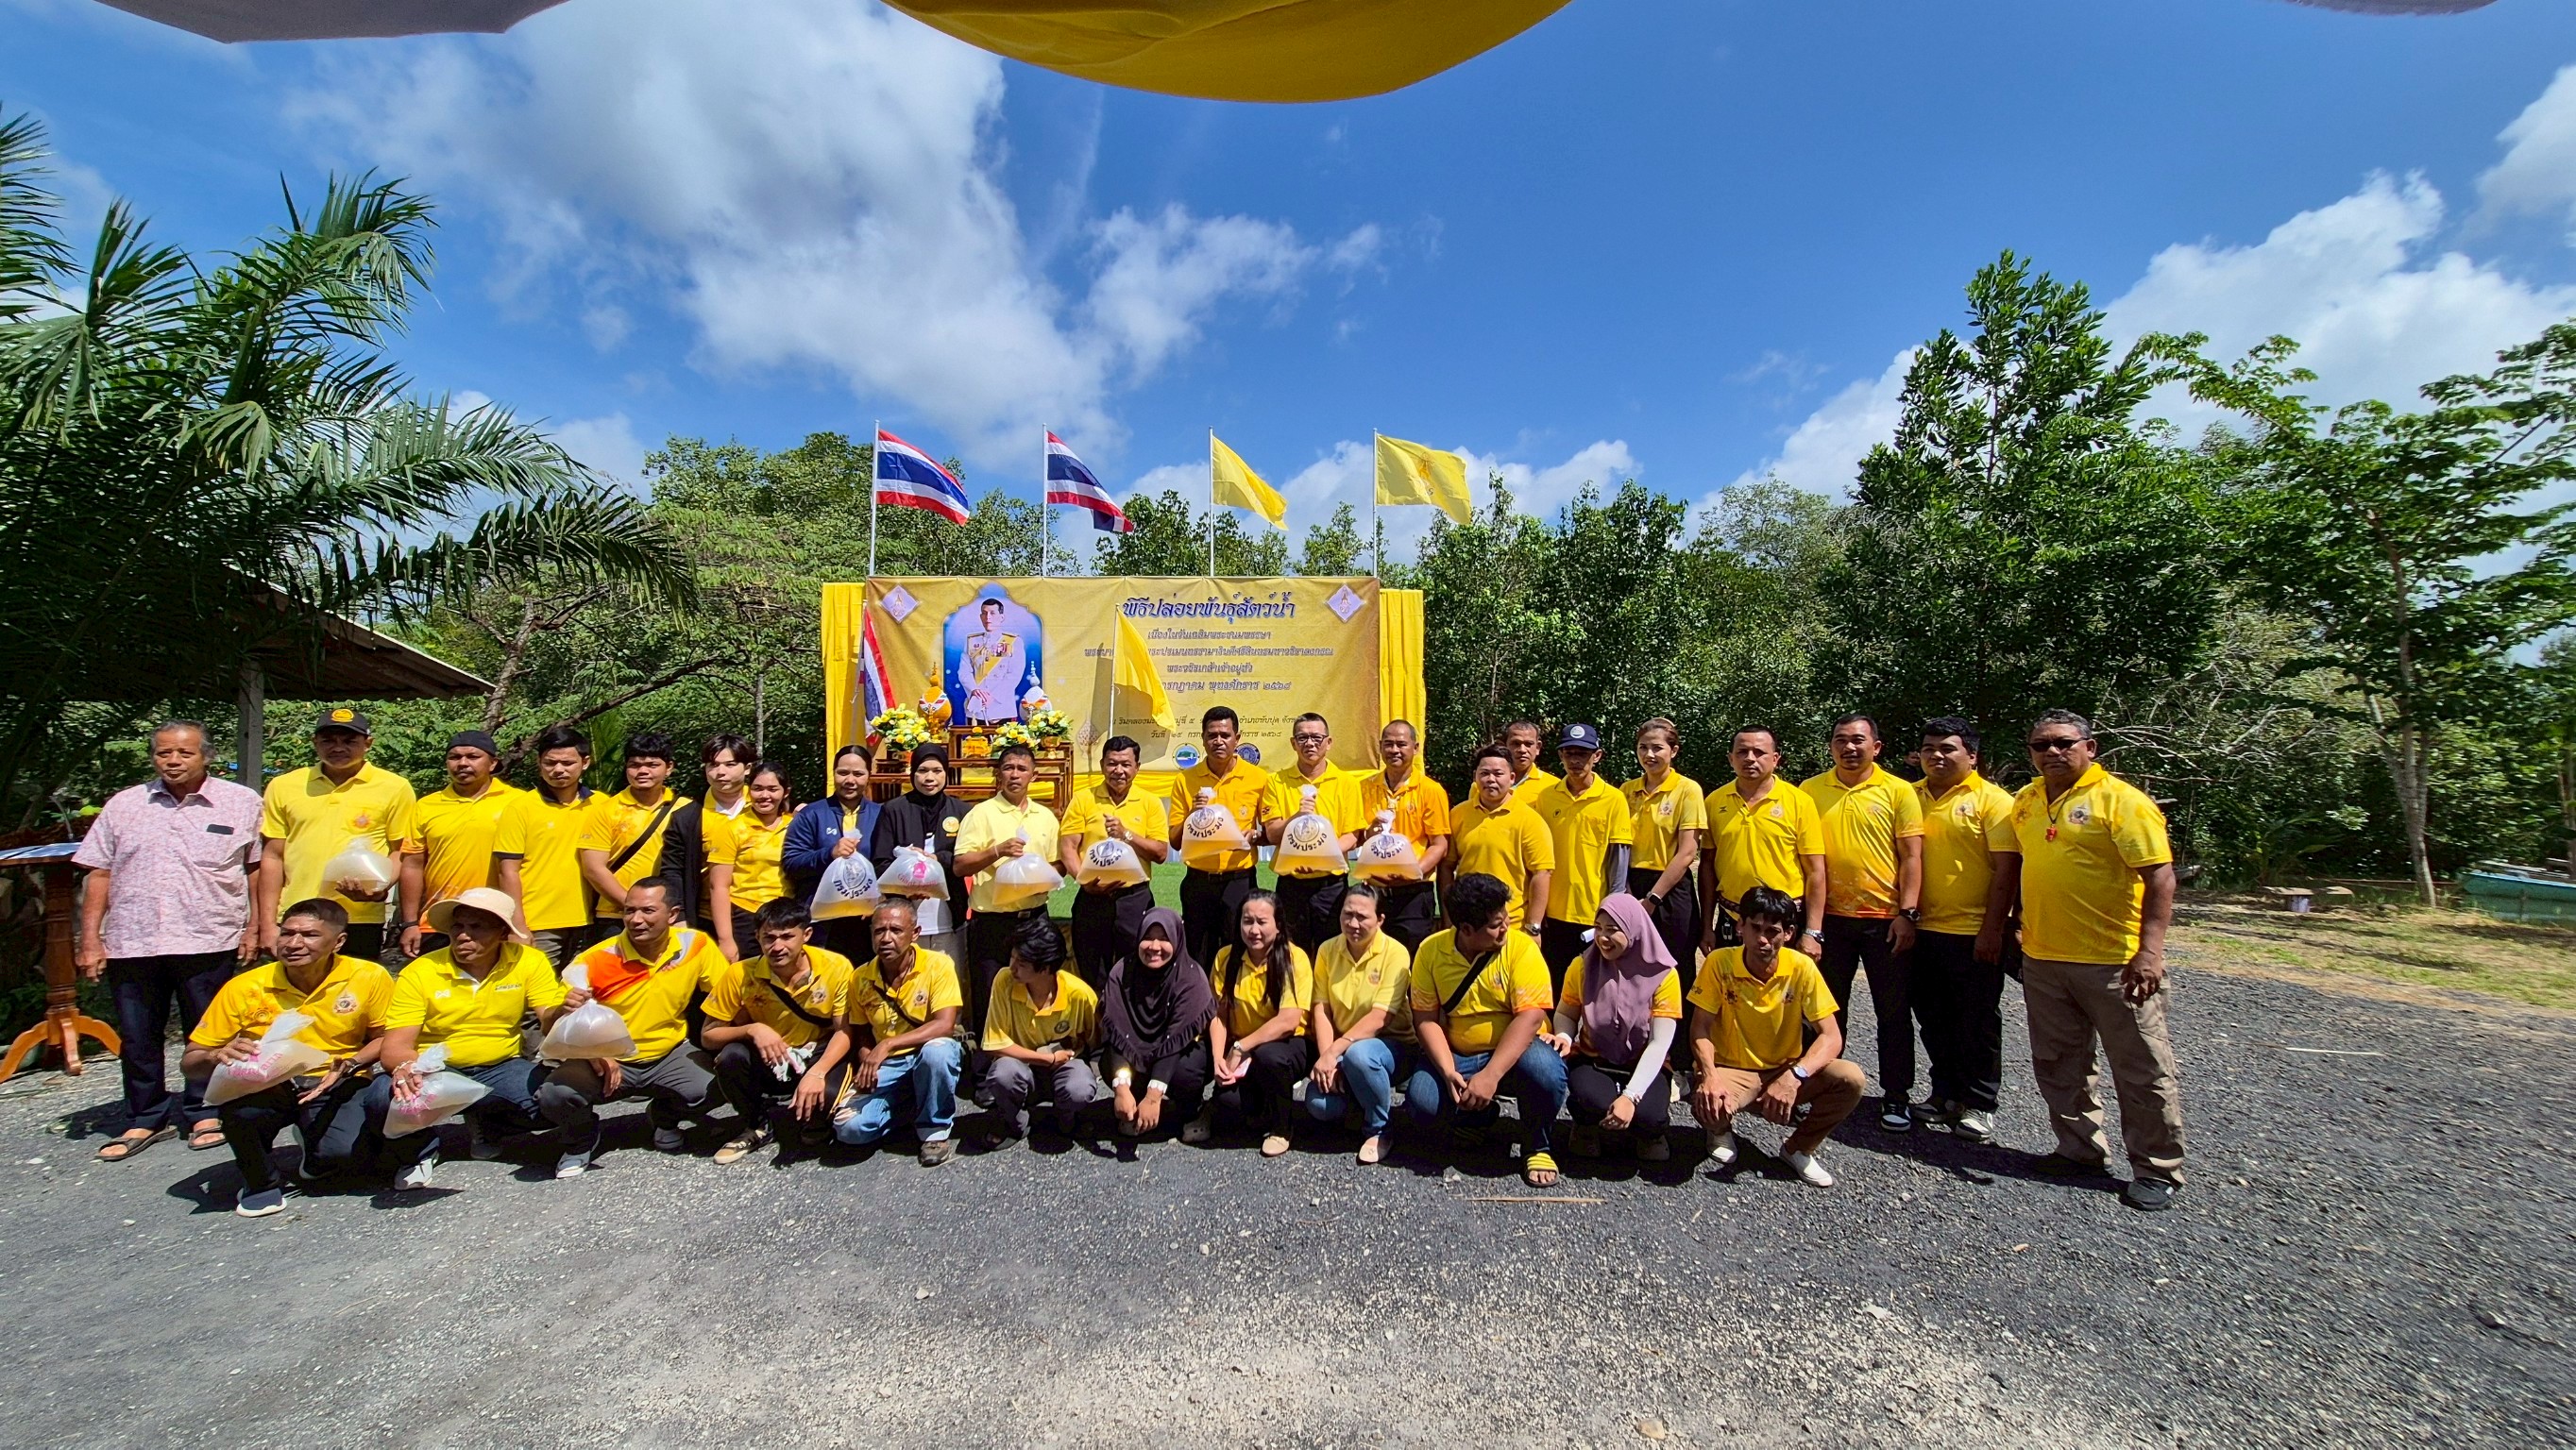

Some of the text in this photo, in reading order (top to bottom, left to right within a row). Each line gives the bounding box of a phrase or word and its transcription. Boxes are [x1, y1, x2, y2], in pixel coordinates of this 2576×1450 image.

[1123, 592, 1296, 623] พิธีปล่อยพันธุ์สัตว์น้ำ
[1186, 817, 1224, 838] กรมประมง
[1287, 833, 1328, 851] กรมประมง
[834, 878, 873, 899] กรมประมง
